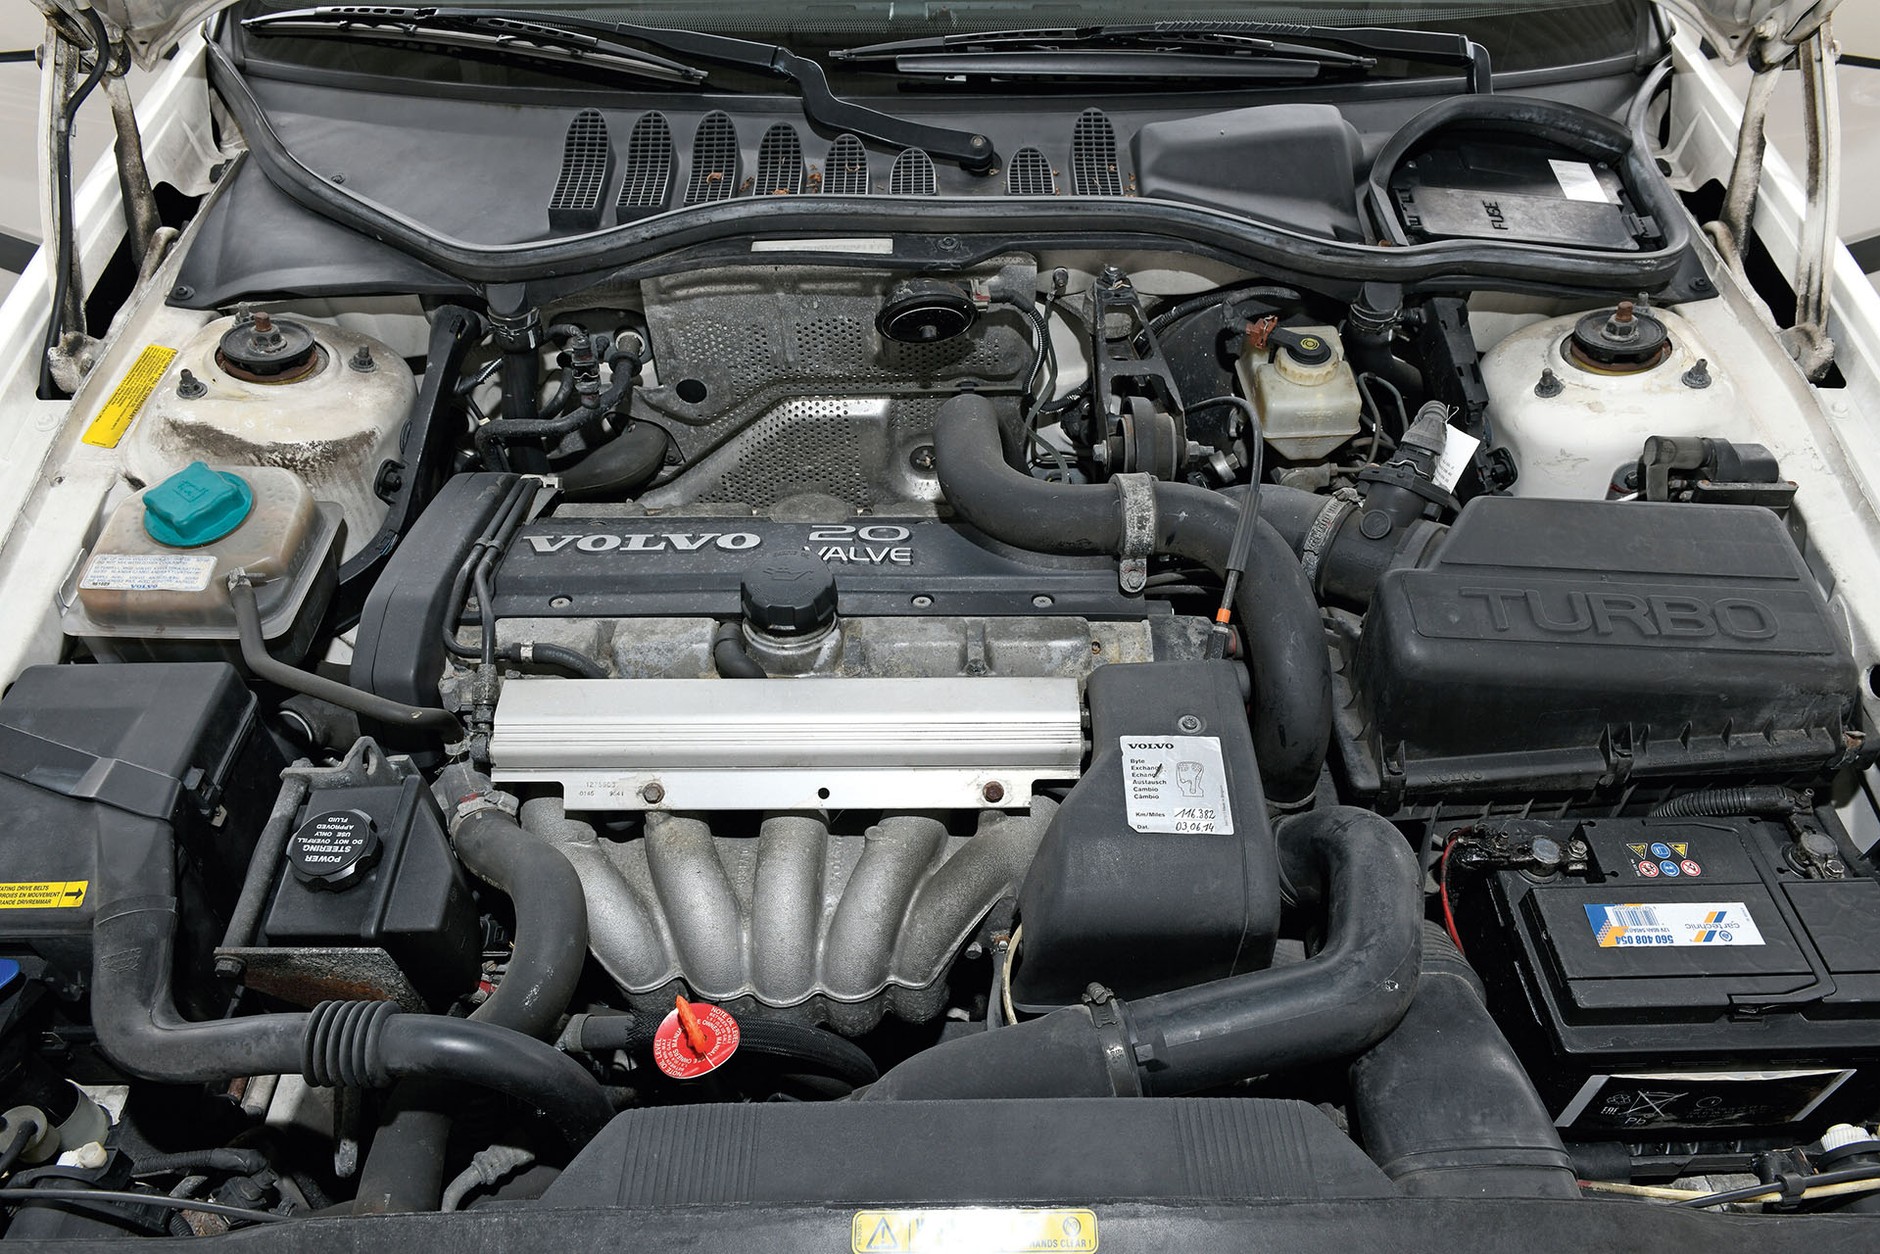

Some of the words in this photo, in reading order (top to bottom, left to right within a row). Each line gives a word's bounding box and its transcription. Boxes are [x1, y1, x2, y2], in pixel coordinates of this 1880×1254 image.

[1482, 200, 1508, 230] FUSE
[808, 524, 910, 543] 20
[522, 534, 762, 553] VOLVO
[802, 546, 914, 564] VALVE
[1459, 586, 1778, 640] TURBO
[1175, 822, 1214, 832] 03.06.14
[302, 844, 352, 853] STEERING
[1684, 920, 1740, 931] cartechnic
[1615, 936, 1633, 945] 054
[1635, 935, 1653, 944] 408
[1655, 935, 1674, 944] 560
[702, 1020, 721, 1036] OWNERS
[711, 1007, 728, 1018] NOTE
[726, 1017, 735, 1027] OIL
[731, 1026, 739, 1044] LEVEL
[672, 1027, 682, 1048] MANUA
[707, 1037, 722, 1056] MANUAL
[659, 1059, 667, 1068] OIL
[672, 1049, 692, 1064] OWNERS
[666, 1067, 682, 1076] NOTE
